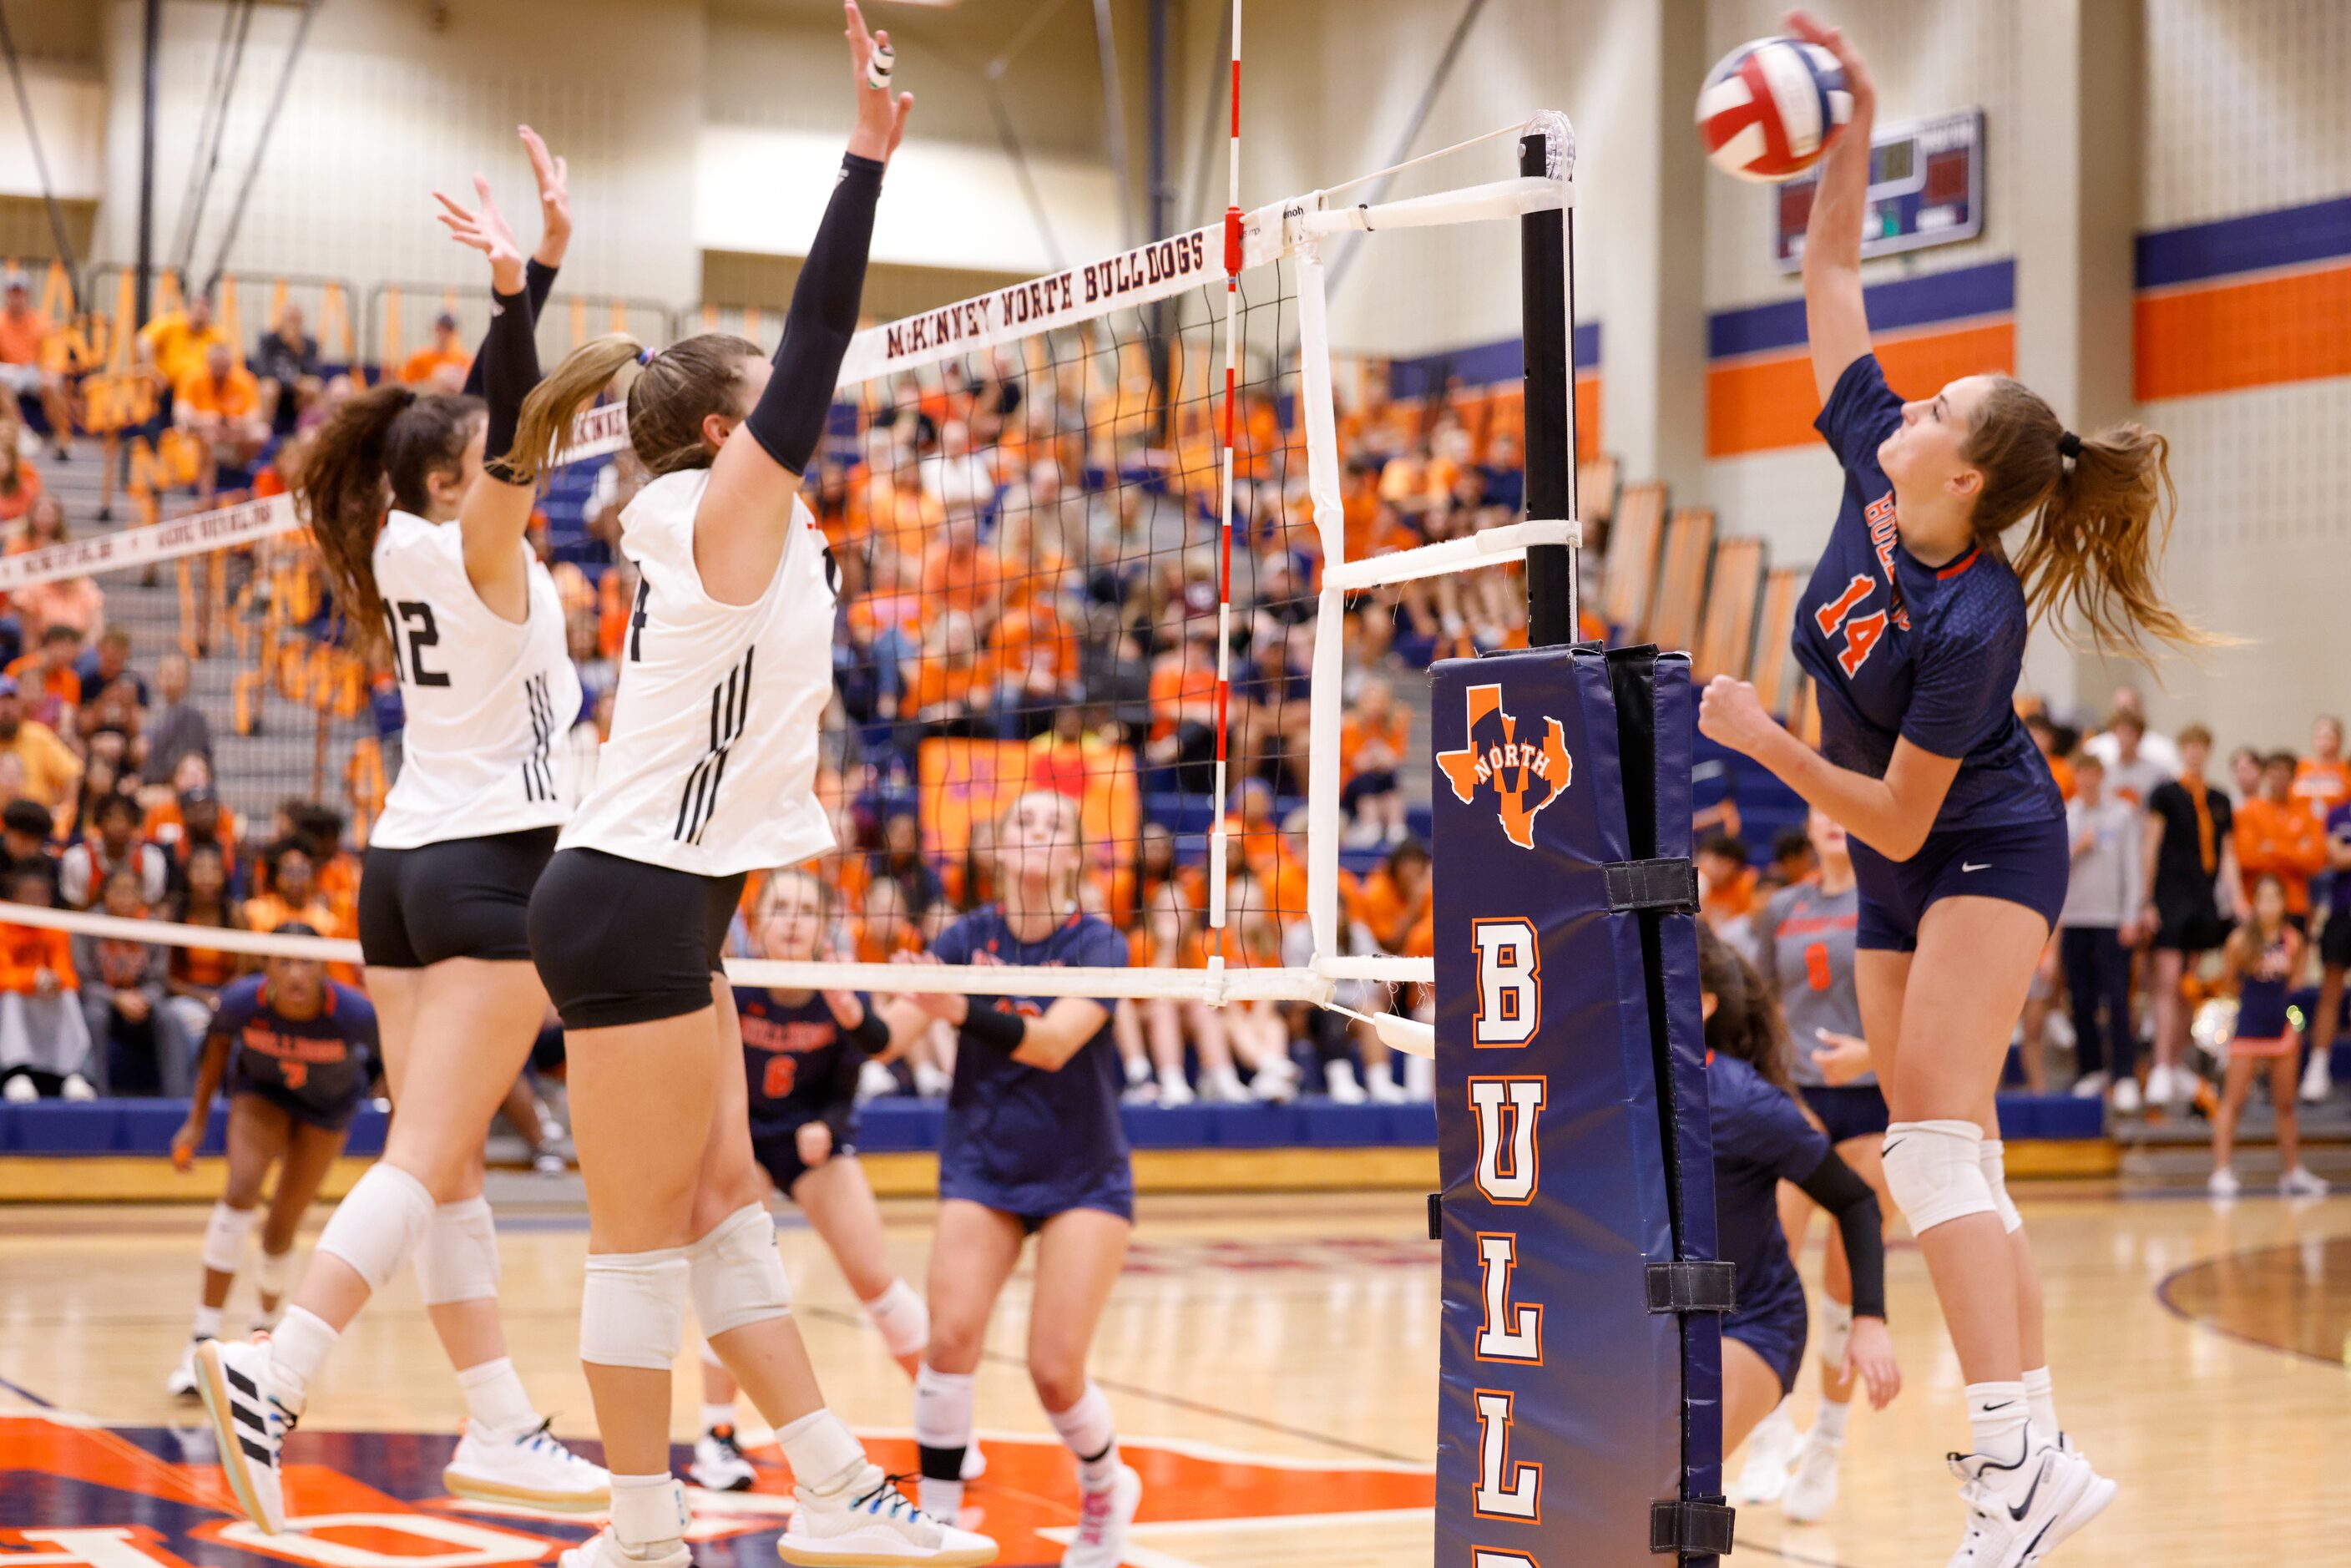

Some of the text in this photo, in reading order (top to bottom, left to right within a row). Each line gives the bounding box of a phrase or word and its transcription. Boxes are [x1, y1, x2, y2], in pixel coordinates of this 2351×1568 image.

[1282, 205, 1304, 220] enoh
[1002, 272, 1074, 326] NORTH
[1084, 231, 1204, 303] BULLDOGS
[382, 598, 451, 686] 12
[1815, 573, 1889, 680] 14
[1473, 742, 1551, 785] NORTH
[761, 1055, 799, 1100] 6
[1467, 916, 1549, 1568] BULL
